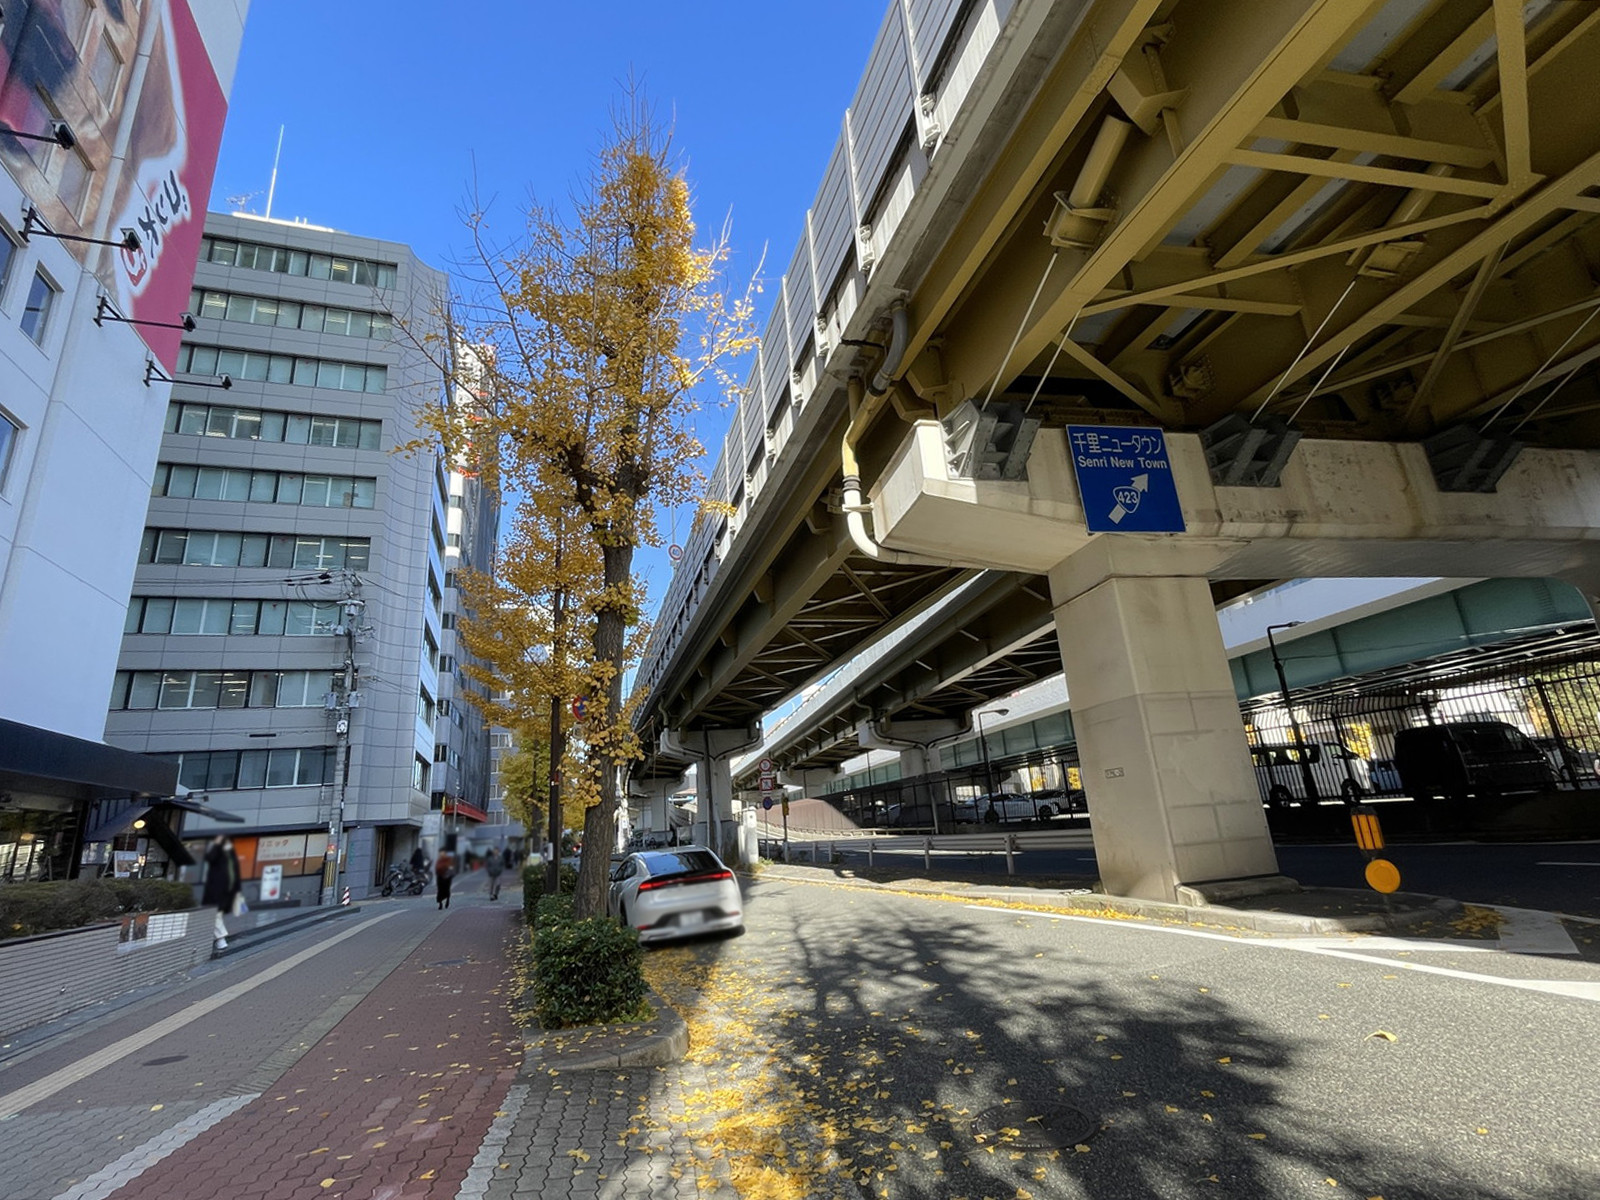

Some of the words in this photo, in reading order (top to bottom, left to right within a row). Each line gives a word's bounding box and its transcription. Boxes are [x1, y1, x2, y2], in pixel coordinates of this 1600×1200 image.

[1073, 433, 1162, 454] 千里ニュータウン
[1078, 456, 1108, 468] Senri
[1110, 456, 1134, 468] New
[1137, 457, 1168, 469] Town
[1118, 491, 1138, 504] 423
